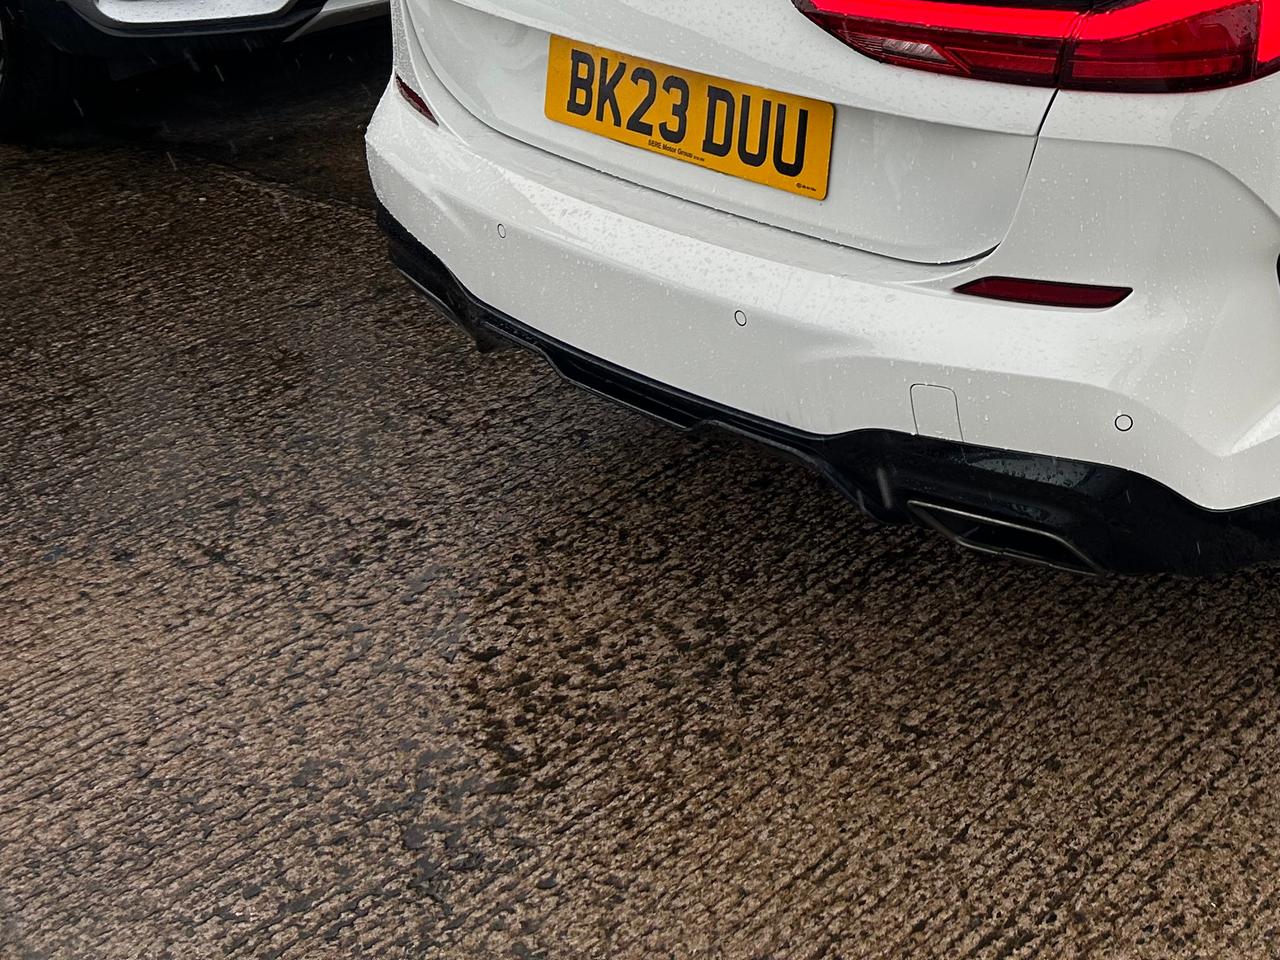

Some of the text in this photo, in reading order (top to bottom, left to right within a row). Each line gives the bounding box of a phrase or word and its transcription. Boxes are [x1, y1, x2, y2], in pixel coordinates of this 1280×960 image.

[566, 48, 808, 178] BK23 DUU
[662, 144, 677, 154] Motor
[677, 148, 693, 159] Group
